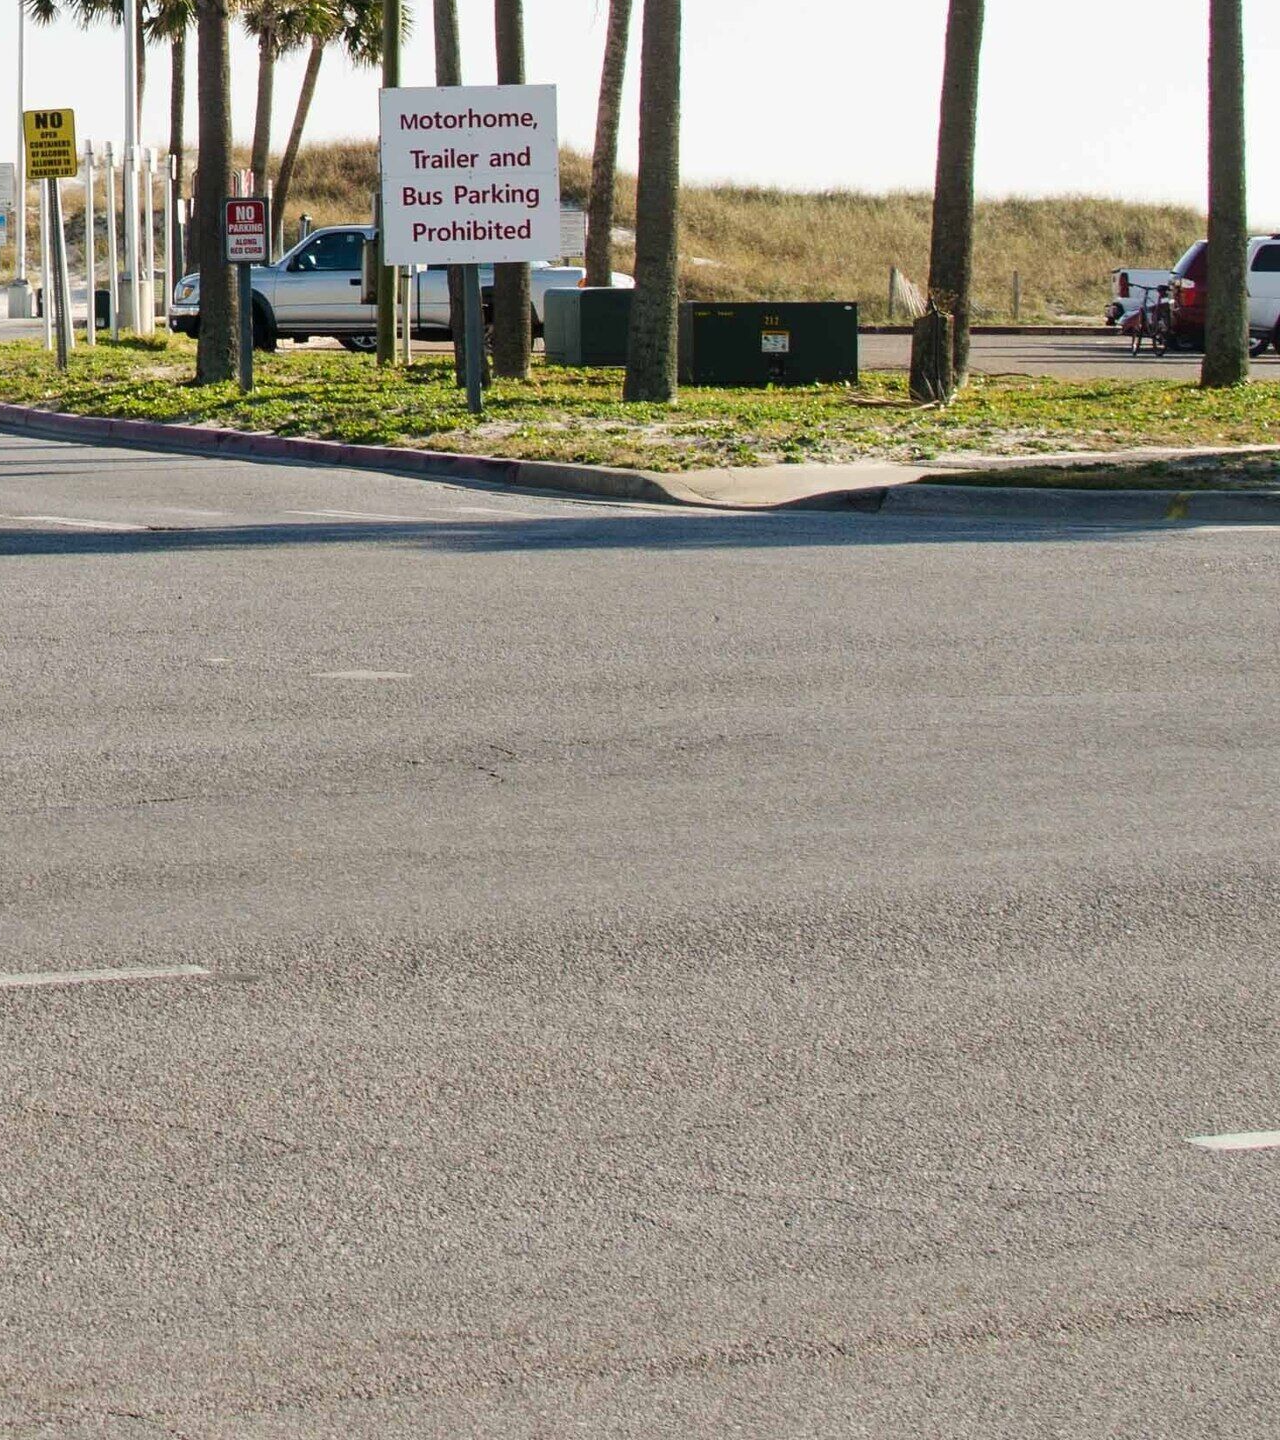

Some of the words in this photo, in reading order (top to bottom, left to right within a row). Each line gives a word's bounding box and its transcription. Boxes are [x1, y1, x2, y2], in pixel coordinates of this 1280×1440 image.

[35, 112, 63, 129] NO
[400, 108, 538, 131] Motorhome,
[410, 148, 479, 169] Trailer
[489, 146, 531, 168] and
[402, 186, 443, 206] Bus
[454, 184, 540, 208] Parking
[235, 206, 255, 221] NO
[228, 223, 263, 233] PARKING
[413, 219, 531, 243] Prohibited
